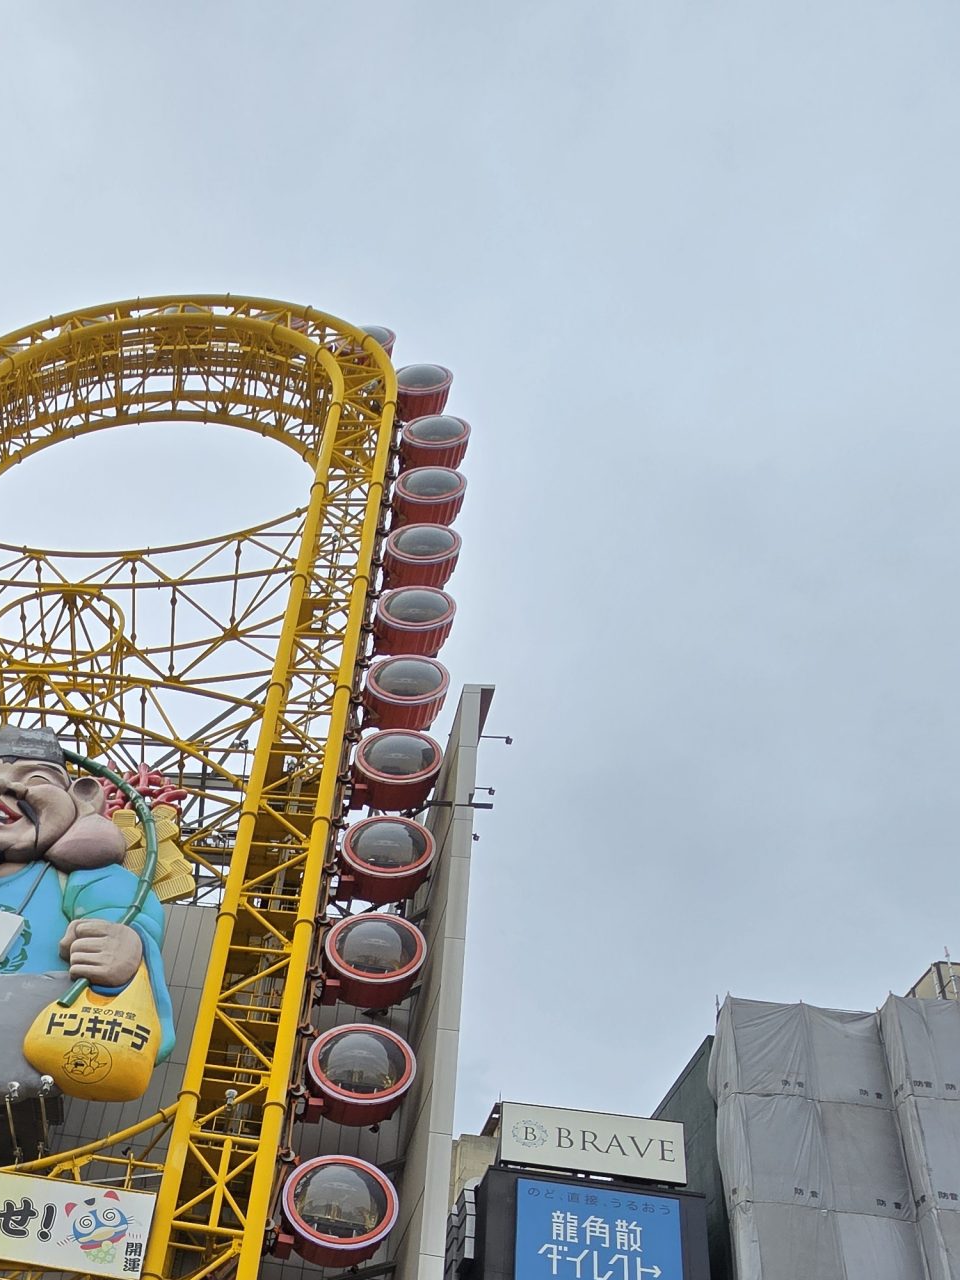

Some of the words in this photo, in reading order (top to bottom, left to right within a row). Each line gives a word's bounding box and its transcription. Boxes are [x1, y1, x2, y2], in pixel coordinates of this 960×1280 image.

[524, 1126, 537, 1141] B
[556, 1126, 676, 1162] BRAVE
[552, 1210, 643, 1253] 龍角散
[122, 1241, 143, 1273] 開運
